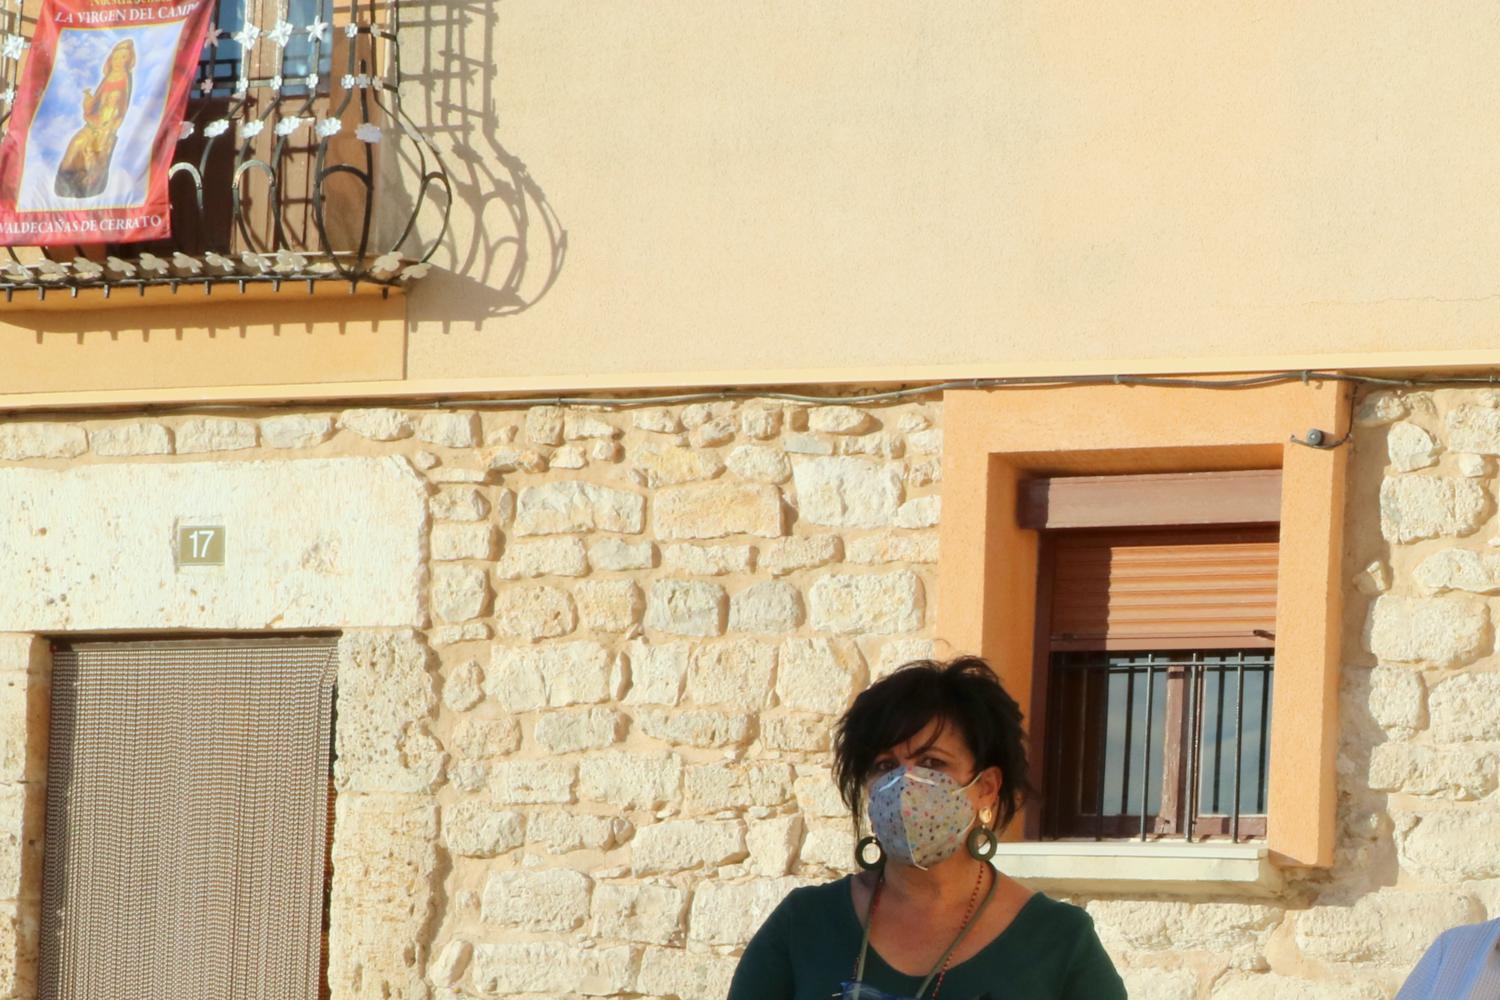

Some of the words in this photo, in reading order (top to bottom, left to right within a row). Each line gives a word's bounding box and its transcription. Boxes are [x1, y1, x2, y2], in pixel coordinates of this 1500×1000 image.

[54, 11, 73, 23] LA
[77, 9, 126, 24] VIRGEN
[129, 7, 156, 21] DEL
[80, 219, 98, 232] DE
[100, 215, 162, 231] CERRATO
[189, 530, 215, 558] 17
